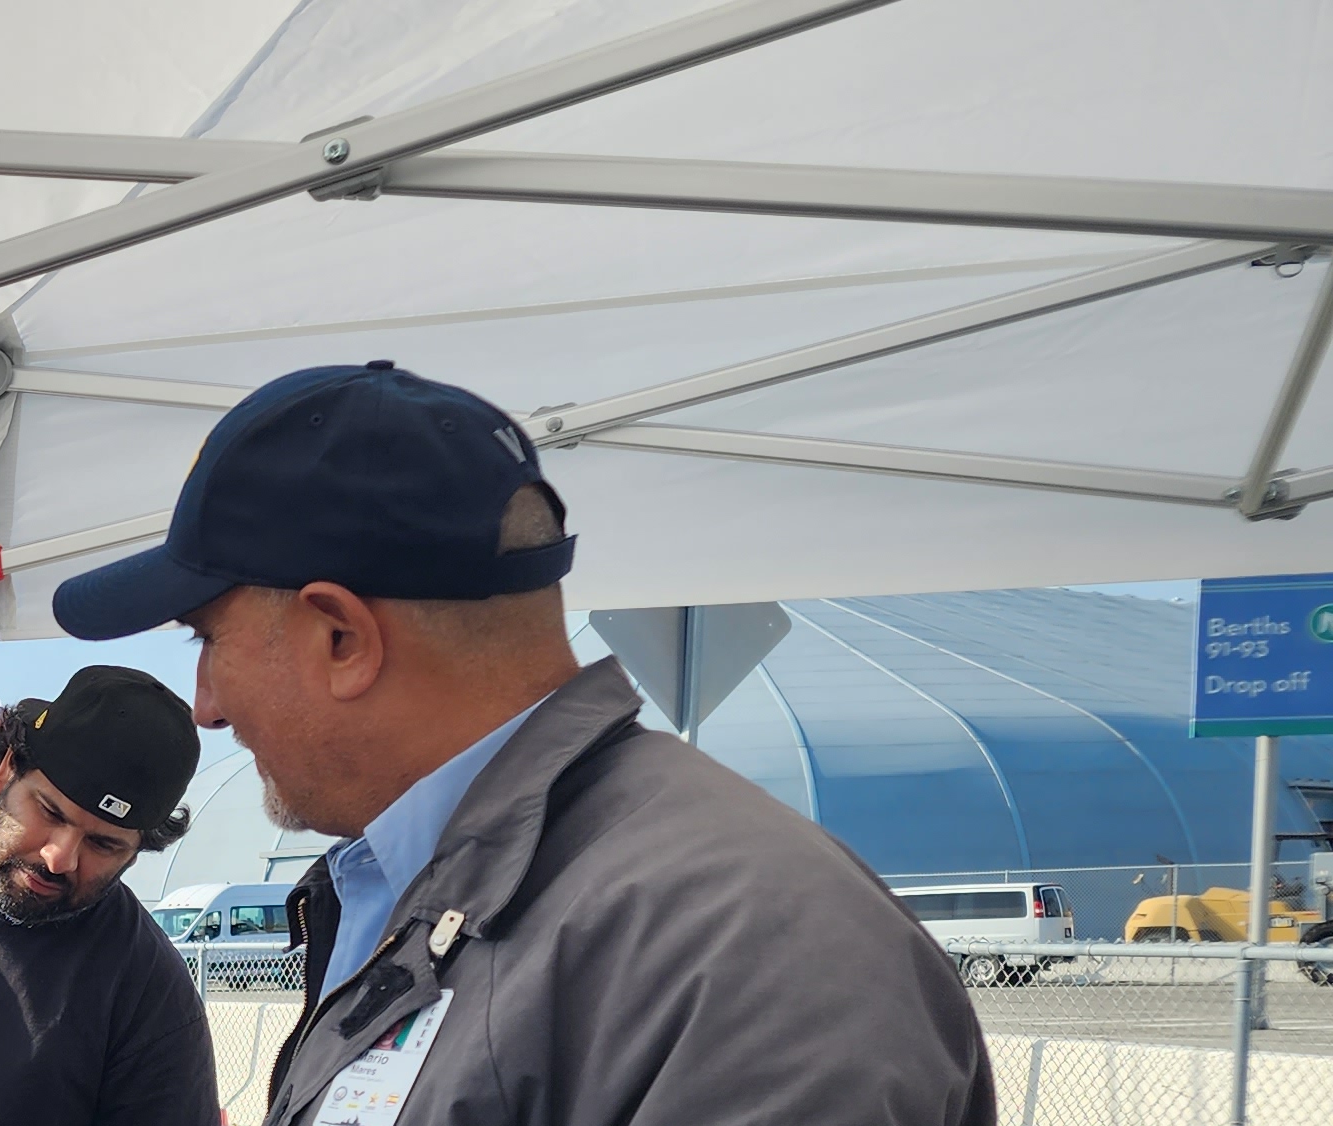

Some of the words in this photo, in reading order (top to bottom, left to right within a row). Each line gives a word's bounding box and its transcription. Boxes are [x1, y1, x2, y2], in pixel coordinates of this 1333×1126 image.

[1207, 615, 1291, 637] Berths
[1205, 640, 1270, 659] 91-93
[1204, 675, 1268, 698] Drop
[1271, 671, 1312, 692] off
